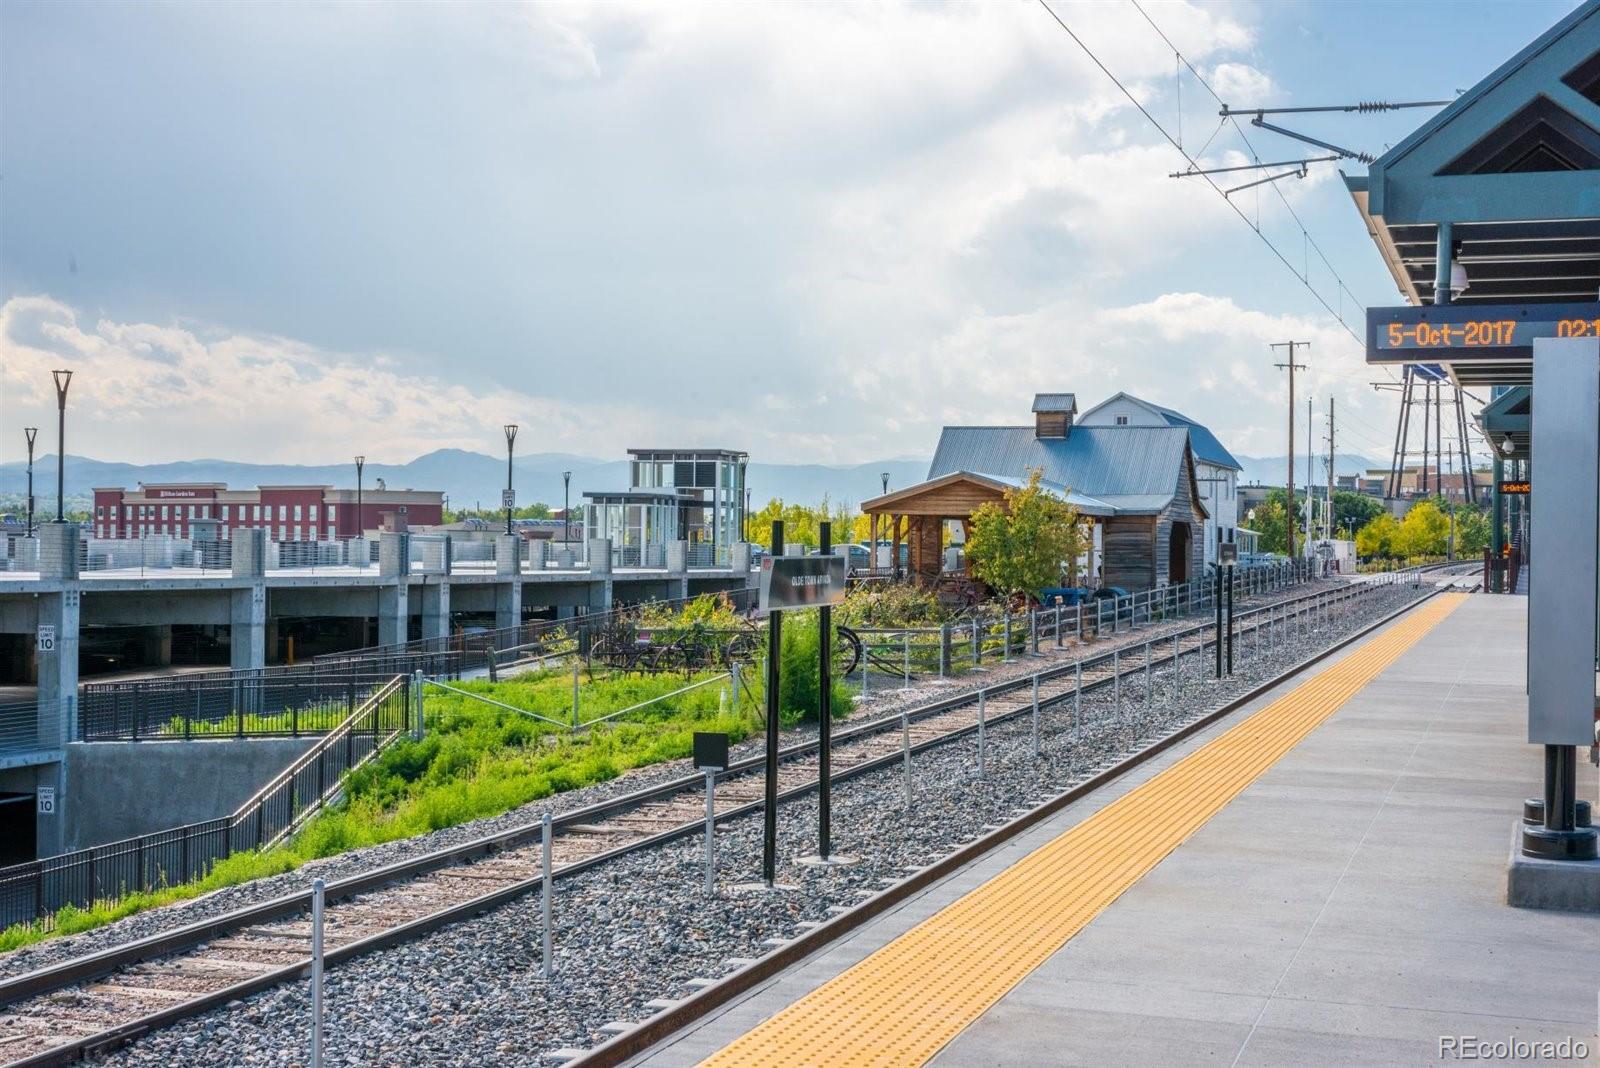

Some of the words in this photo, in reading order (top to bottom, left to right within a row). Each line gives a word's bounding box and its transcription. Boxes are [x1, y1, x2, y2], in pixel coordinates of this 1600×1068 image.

[1388, 320, 1516, 347] 5-Oct-2017
[504, 499, 513, 507] 10
[40, 638, 53, 649] 10
[40, 800, 53, 812] 10
